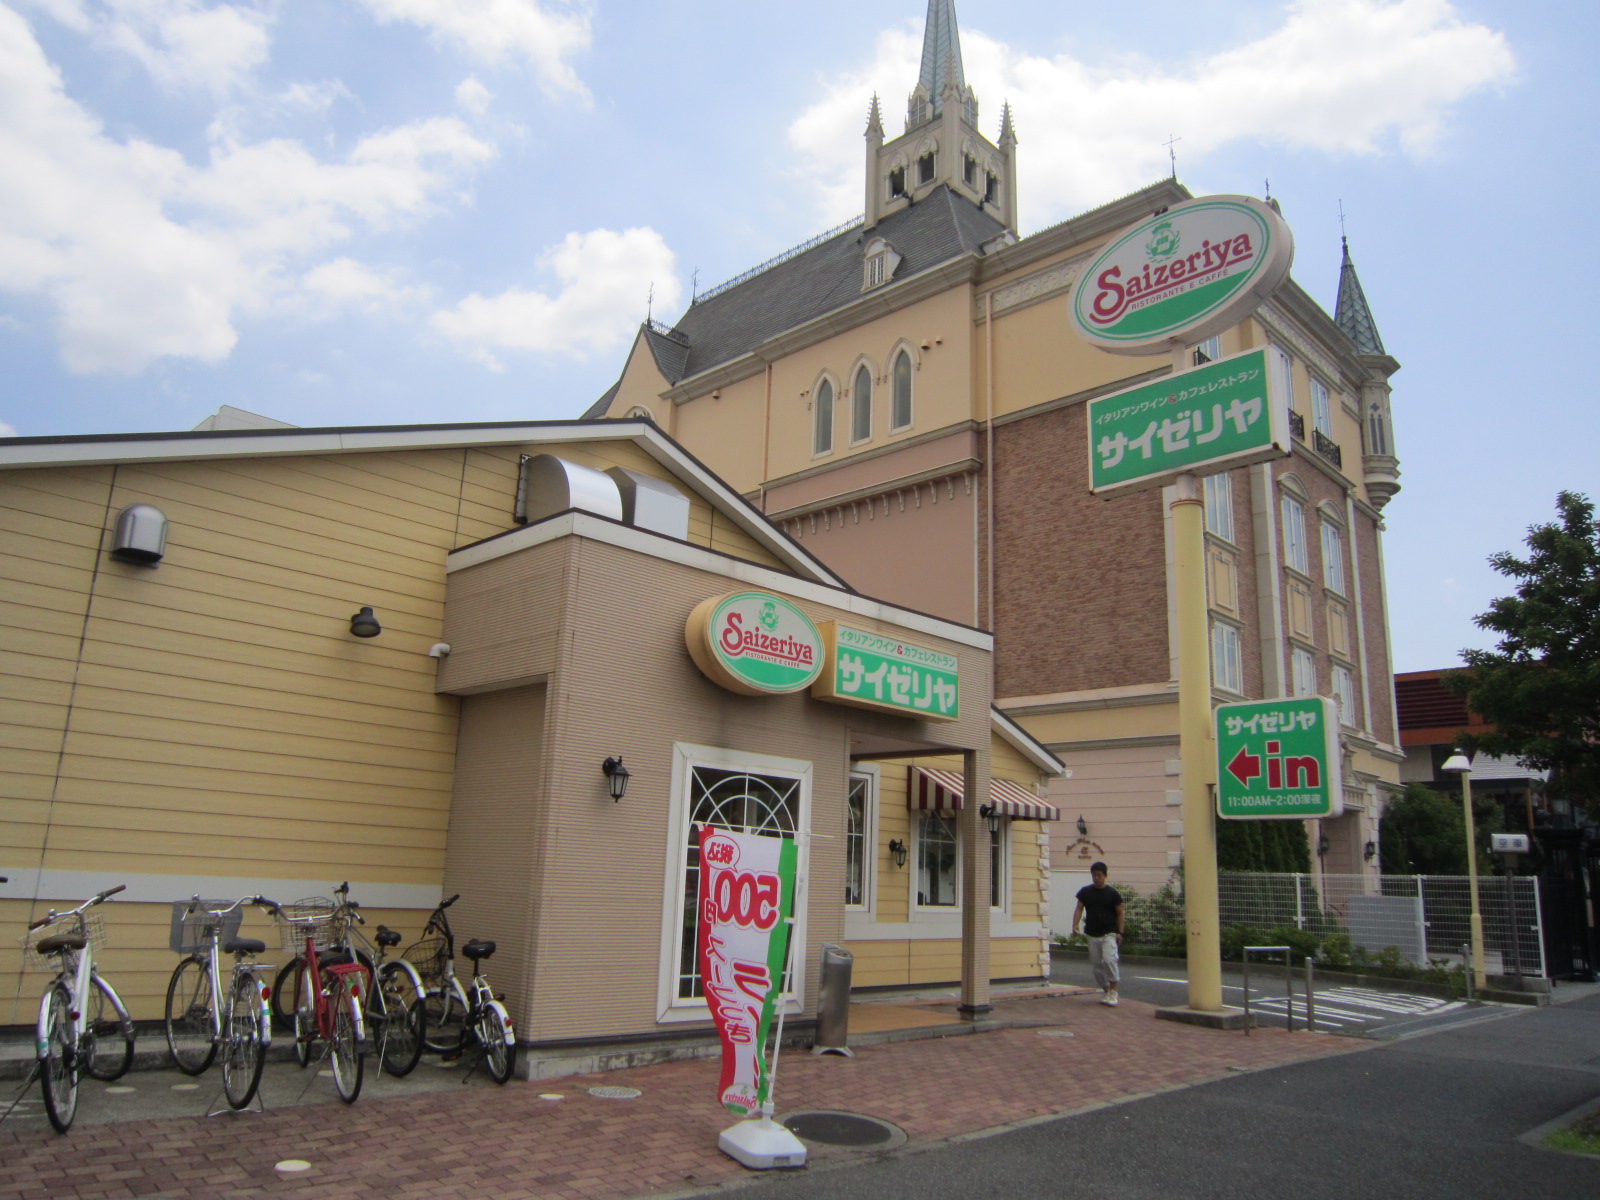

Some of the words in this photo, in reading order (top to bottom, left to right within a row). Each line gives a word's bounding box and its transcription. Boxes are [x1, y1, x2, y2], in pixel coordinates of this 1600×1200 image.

[1091, 233, 1252, 319] Saizeriya
[1131, 286, 1185, 311] RISTORANTE
[1189, 281, 1195, 289] E
[1097, 397, 1262, 469] サイゼリヤ
[721, 612, 813, 661] Saizeriya
[745, 651, 777, 664] RISTORANTE
[839, 653, 956, 713] サイゼリヤ
[1225, 711, 1316, 735] サイゼリヤ
[1265, 740, 1322, 790] in
